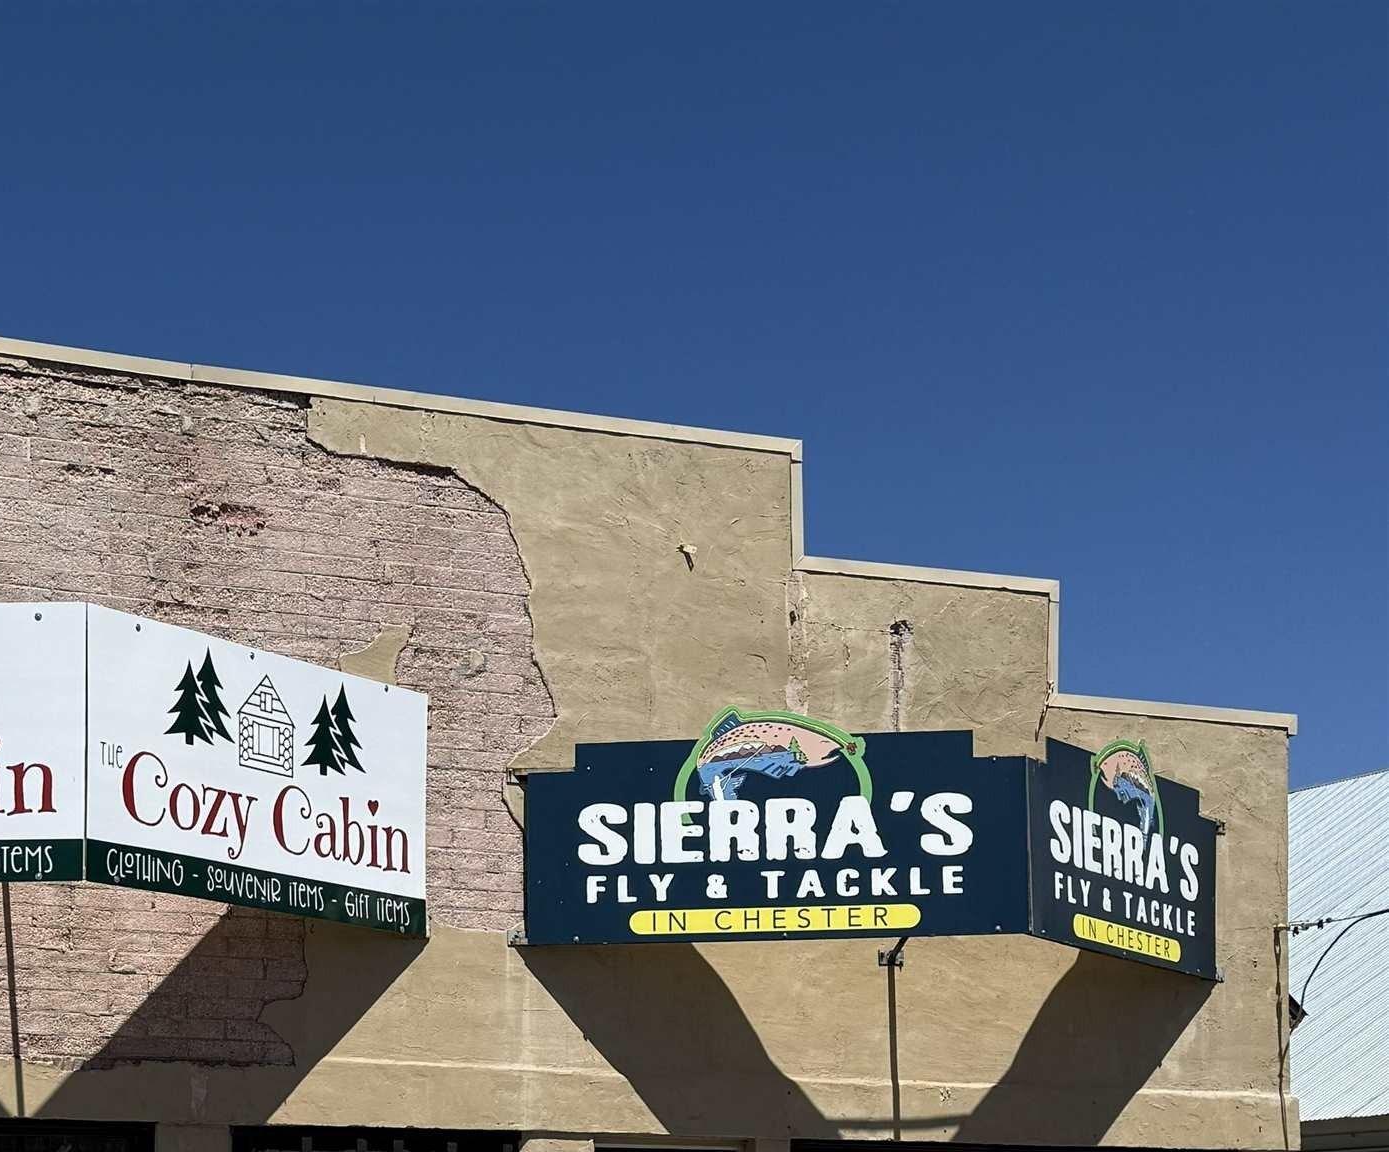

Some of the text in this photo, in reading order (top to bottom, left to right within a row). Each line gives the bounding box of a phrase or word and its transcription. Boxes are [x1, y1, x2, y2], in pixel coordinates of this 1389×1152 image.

[122, 750, 259, 860] Cozy
[272, 784, 412, 875] Cabin
[576, 791, 975, 866] SIERRA'S
[1049, 799, 1200, 902] SIERRA'S
[586, 865, 965, 904] FLY & TACKLE
[1054, 871, 1197, 937] FLY & TACKLE
[651, 905, 890, 933] IN CHESTER
[1081, 916, 1171, 959] IN CHESTER
